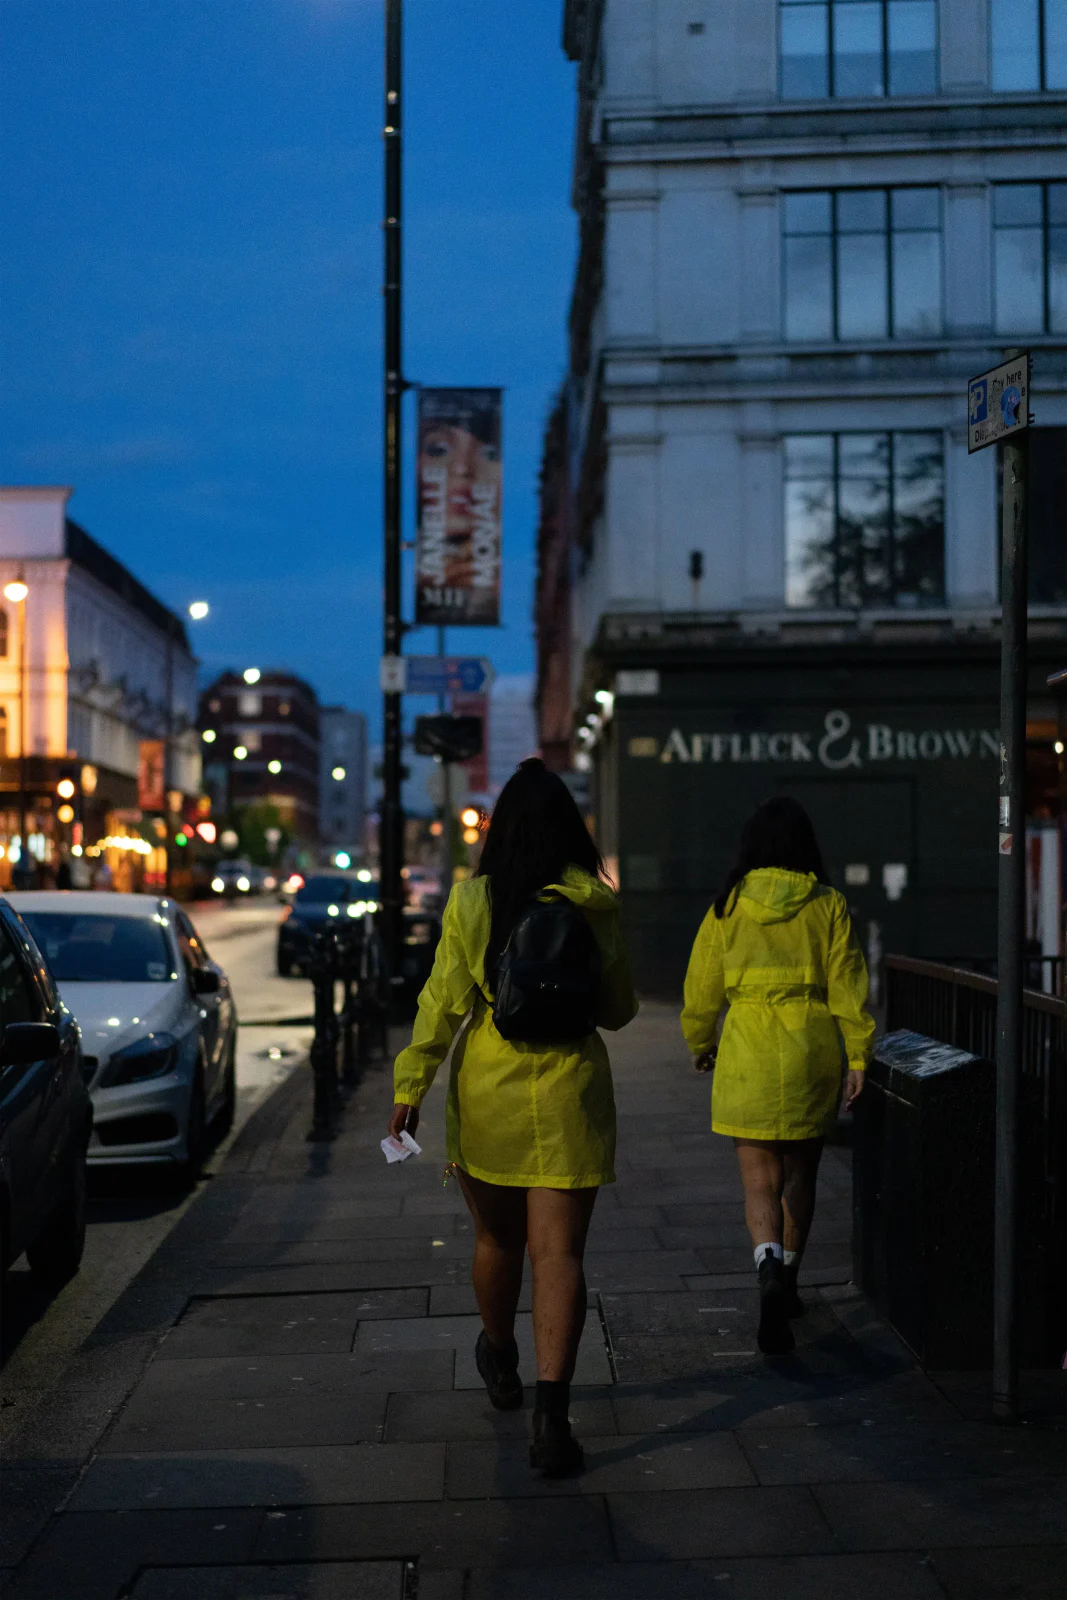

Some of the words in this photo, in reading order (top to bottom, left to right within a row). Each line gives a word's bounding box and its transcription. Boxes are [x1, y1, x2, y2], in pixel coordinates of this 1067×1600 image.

[1007, 370, 1021, 386] here
[661, 727, 813, 762] AFFLECK
[818, 709, 863, 769] &
[867, 725, 1000, 760] BROWN
